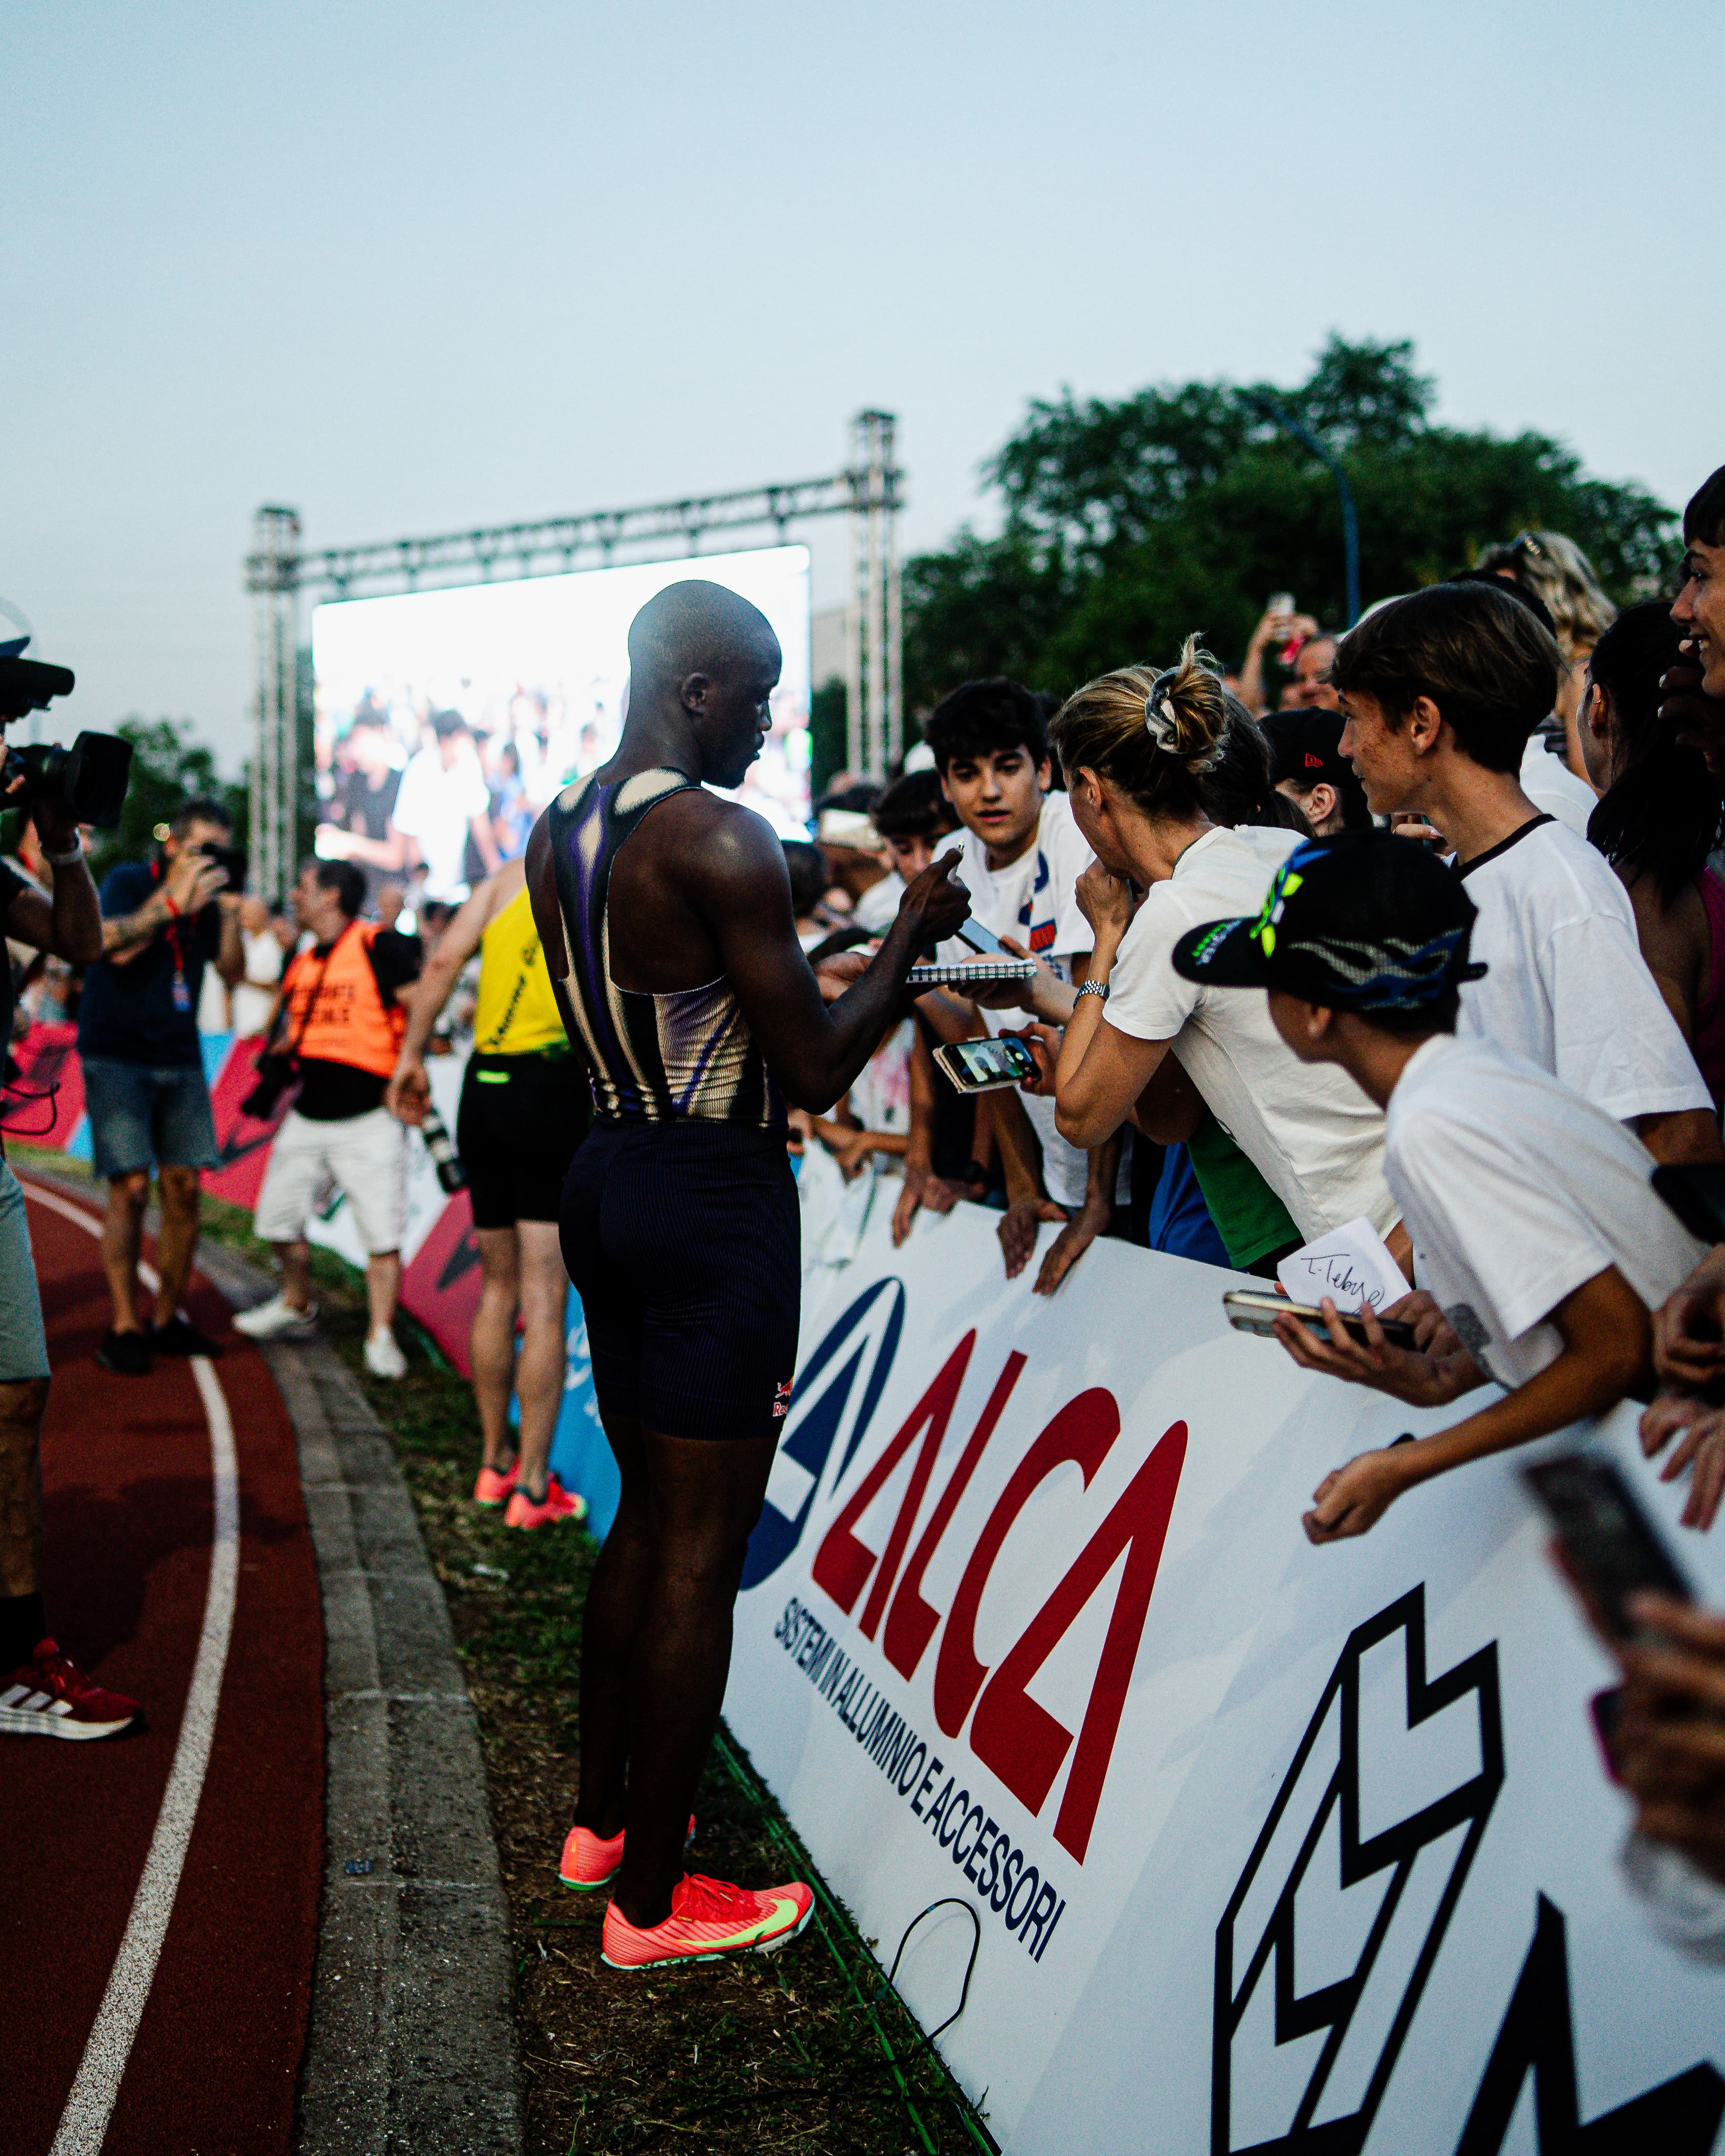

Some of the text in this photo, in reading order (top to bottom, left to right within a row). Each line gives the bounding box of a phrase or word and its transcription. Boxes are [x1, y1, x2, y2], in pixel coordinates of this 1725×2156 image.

[774, 1596, 1067, 1964] SISTEMI IN ALLUMINIO E ACCESSORI
[811, 1328, 1188, 1866] ALCA
